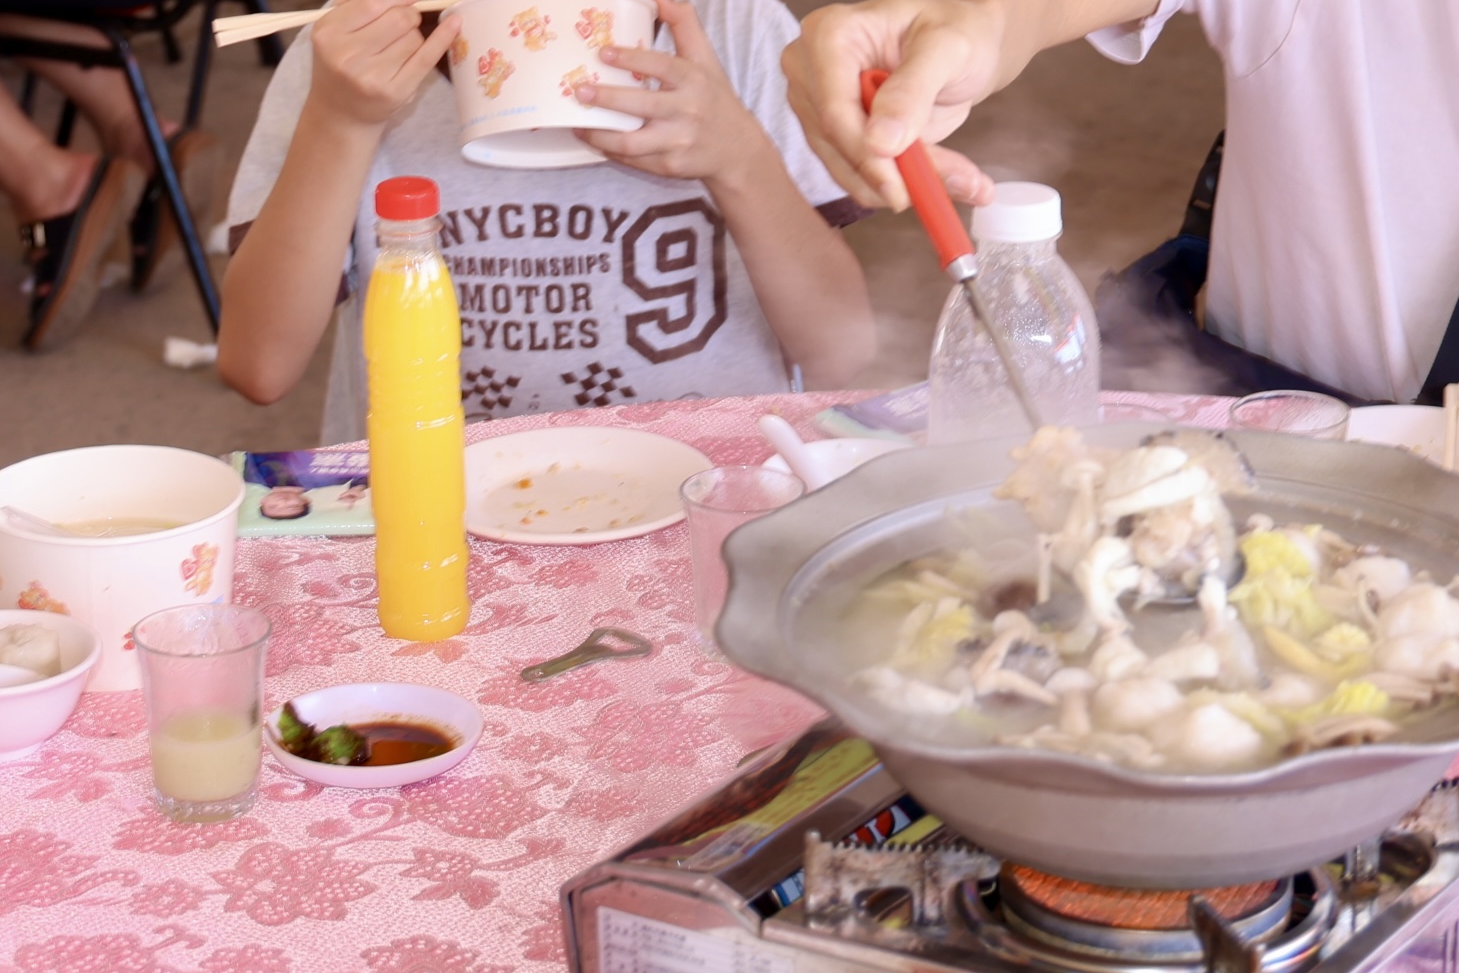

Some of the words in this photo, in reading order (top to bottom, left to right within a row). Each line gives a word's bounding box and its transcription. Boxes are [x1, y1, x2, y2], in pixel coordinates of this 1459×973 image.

[437, 203, 630, 248] NYCBOY
[458, 282, 594, 315] MOTOR
[622, 197, 728, 364] 9
[460, 317, 600, 351] CYCLES
